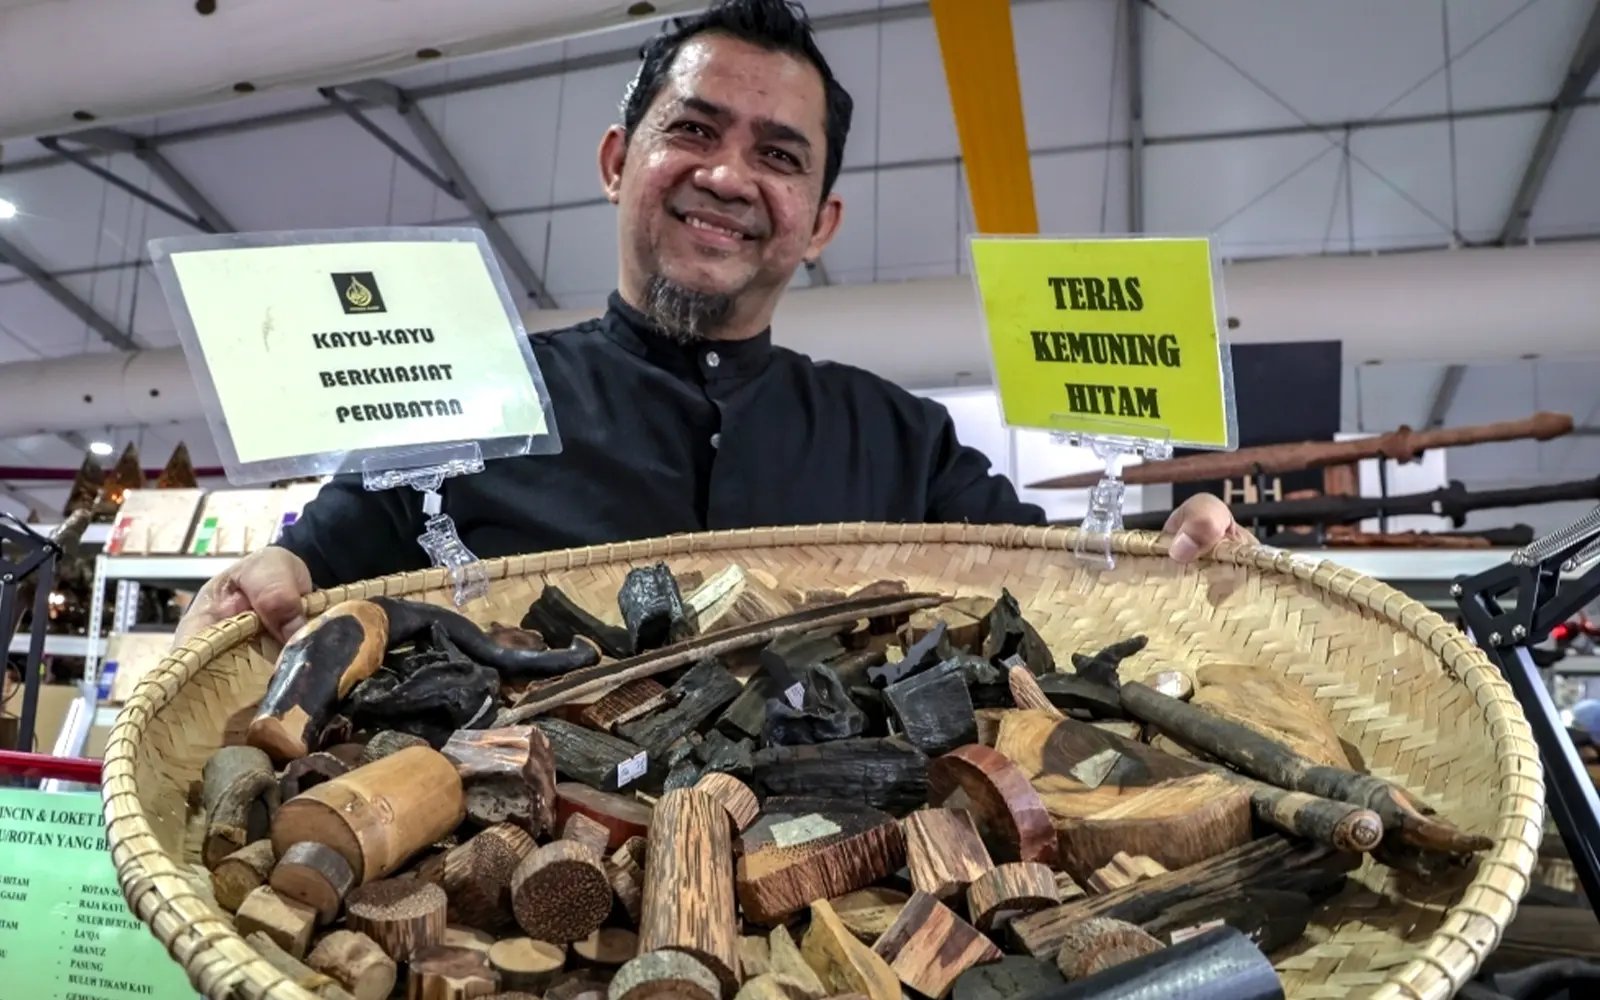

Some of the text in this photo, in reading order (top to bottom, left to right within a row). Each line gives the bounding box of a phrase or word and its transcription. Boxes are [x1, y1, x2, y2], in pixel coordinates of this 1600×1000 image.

[1048, 277, 1144, 311] TERAS
[312, 327, 436, 350] KAYU-KAYU
[1030, 331, 1181, 368] KEMUNING
[319, 364, 453, 388] BERKHASIAT
[336, 399, 463, 423] PERUBATAN
[1065, 383, 1160, 419] HITAM
[36, 809, 47, 823] &
[50, 810, 96, 827] LOKET
[57, 834, 93, 850] YANG
